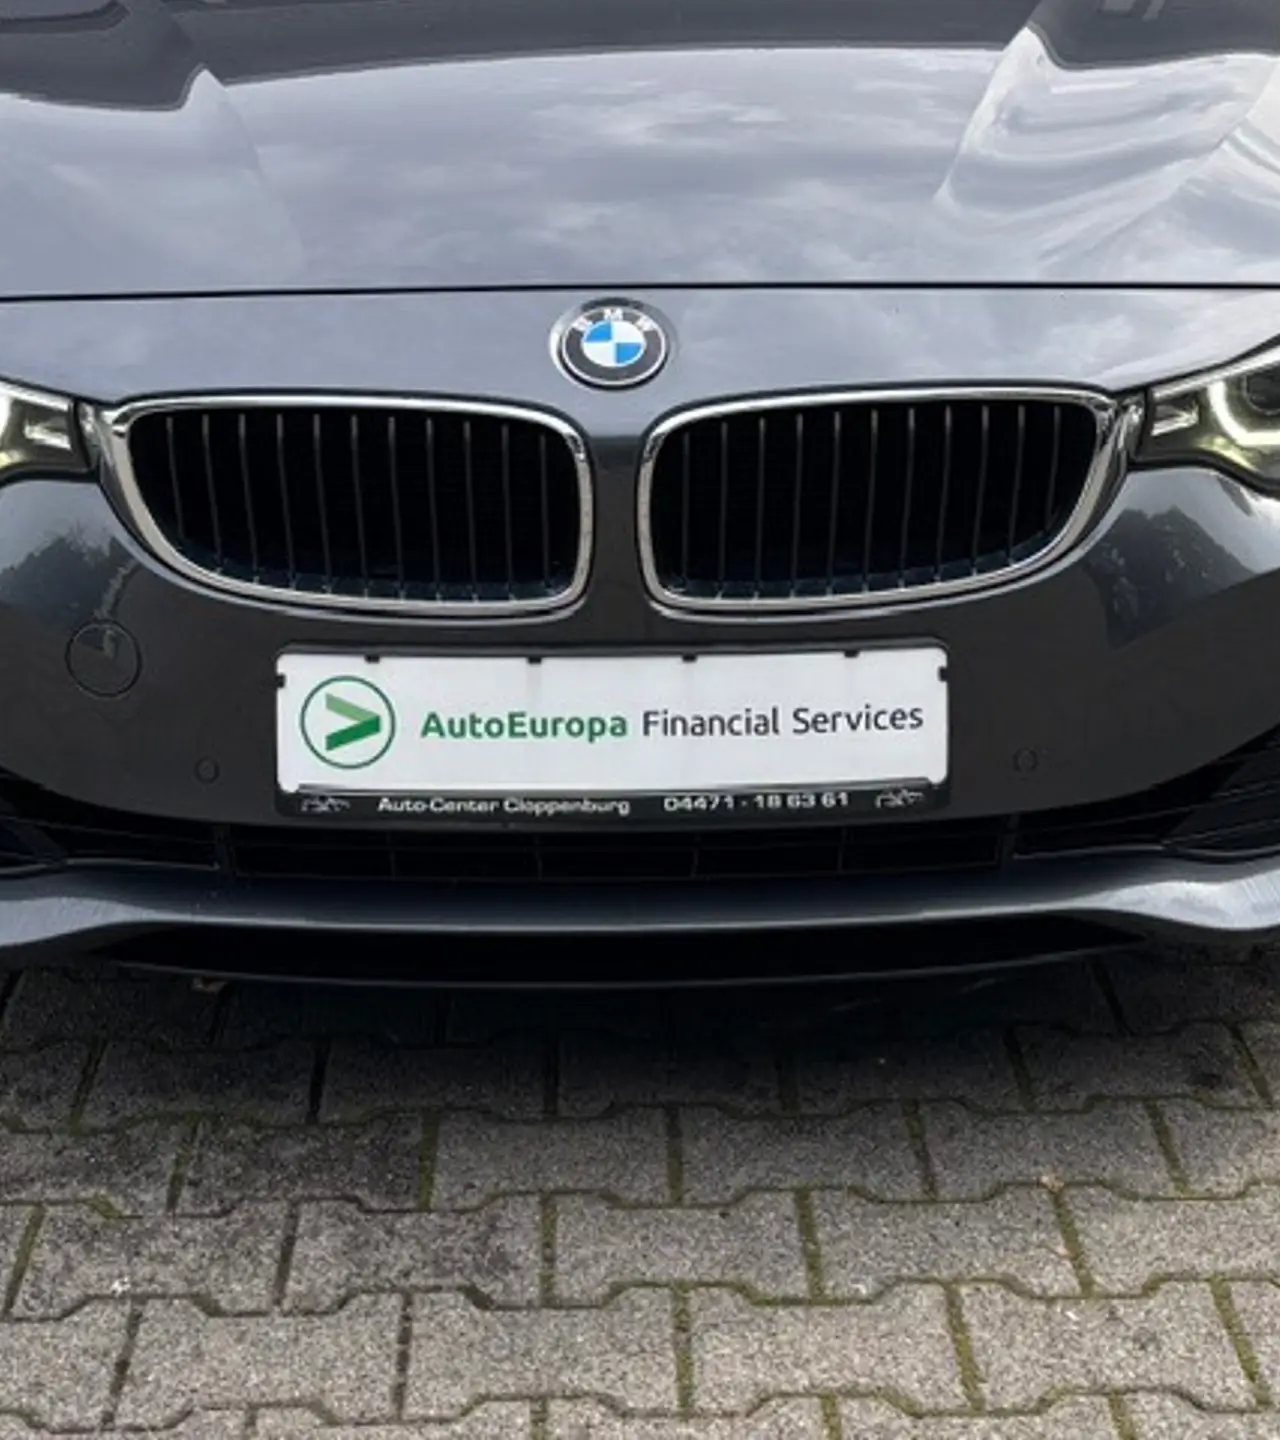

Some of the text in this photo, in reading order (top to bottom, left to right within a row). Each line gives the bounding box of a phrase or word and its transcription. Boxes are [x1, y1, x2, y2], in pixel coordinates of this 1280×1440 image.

[420, 703, 925, 744] AutoEuropa Financial Services
[503, 796, 631, 817] Cloppenburg
[663, 793, 735, 812] 04471
[756, 792, 782, 809] 18
[786, 792, 816, 809] 63
[821, 790, 849, 808] 61
